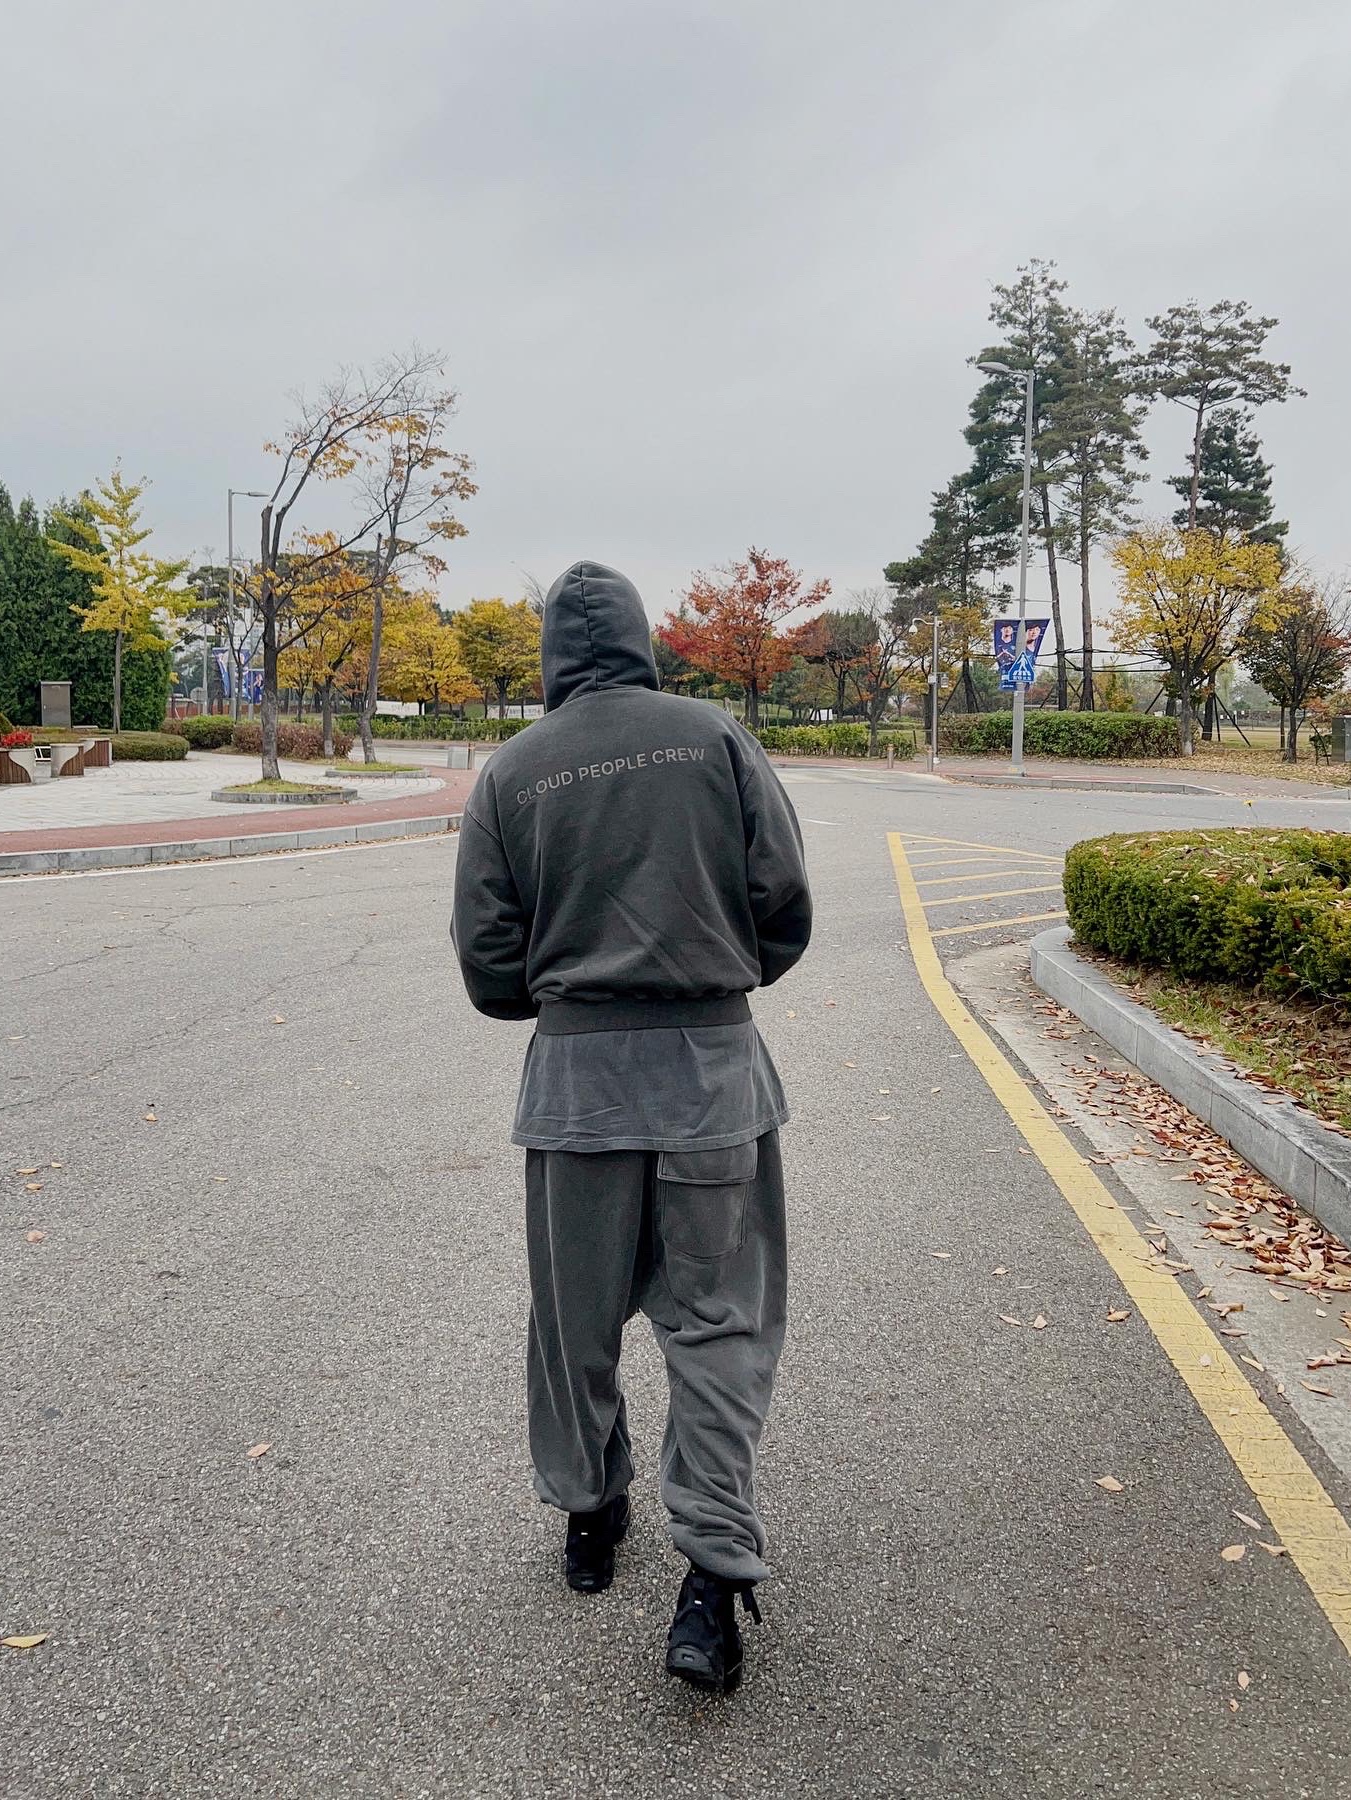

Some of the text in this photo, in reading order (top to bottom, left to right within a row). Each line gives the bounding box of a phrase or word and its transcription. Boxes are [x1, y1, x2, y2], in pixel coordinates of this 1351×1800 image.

[517, 747, 705, 805] CLOUD PEOPLE CREW
